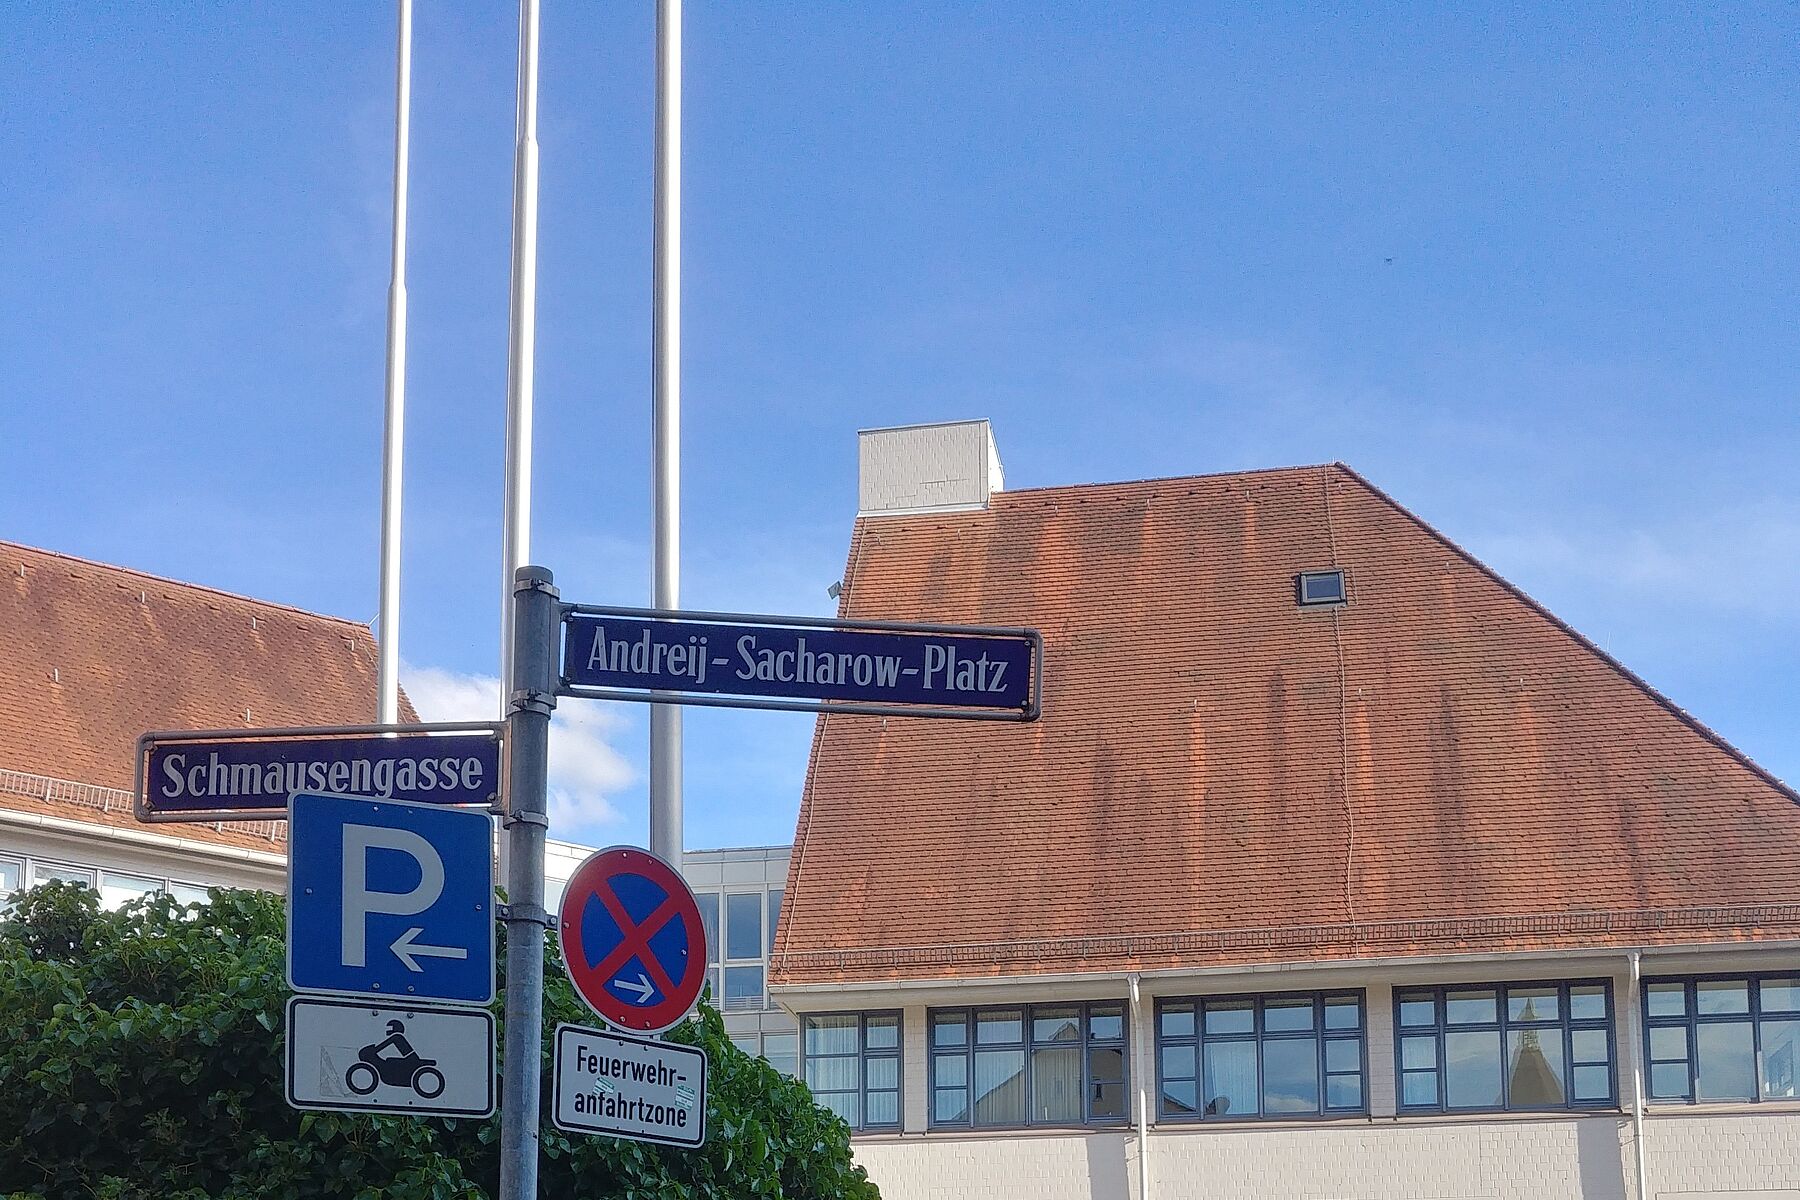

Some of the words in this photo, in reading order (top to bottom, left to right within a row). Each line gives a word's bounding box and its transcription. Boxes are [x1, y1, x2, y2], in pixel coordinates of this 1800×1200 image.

[161, 752, 483, 799] Schmausengasse
[342, 823, 445, 967] P
[577, 1045, 687, 1087] Feuerwehr-
[574, 1092, 687, 1128] anfahrtzone
